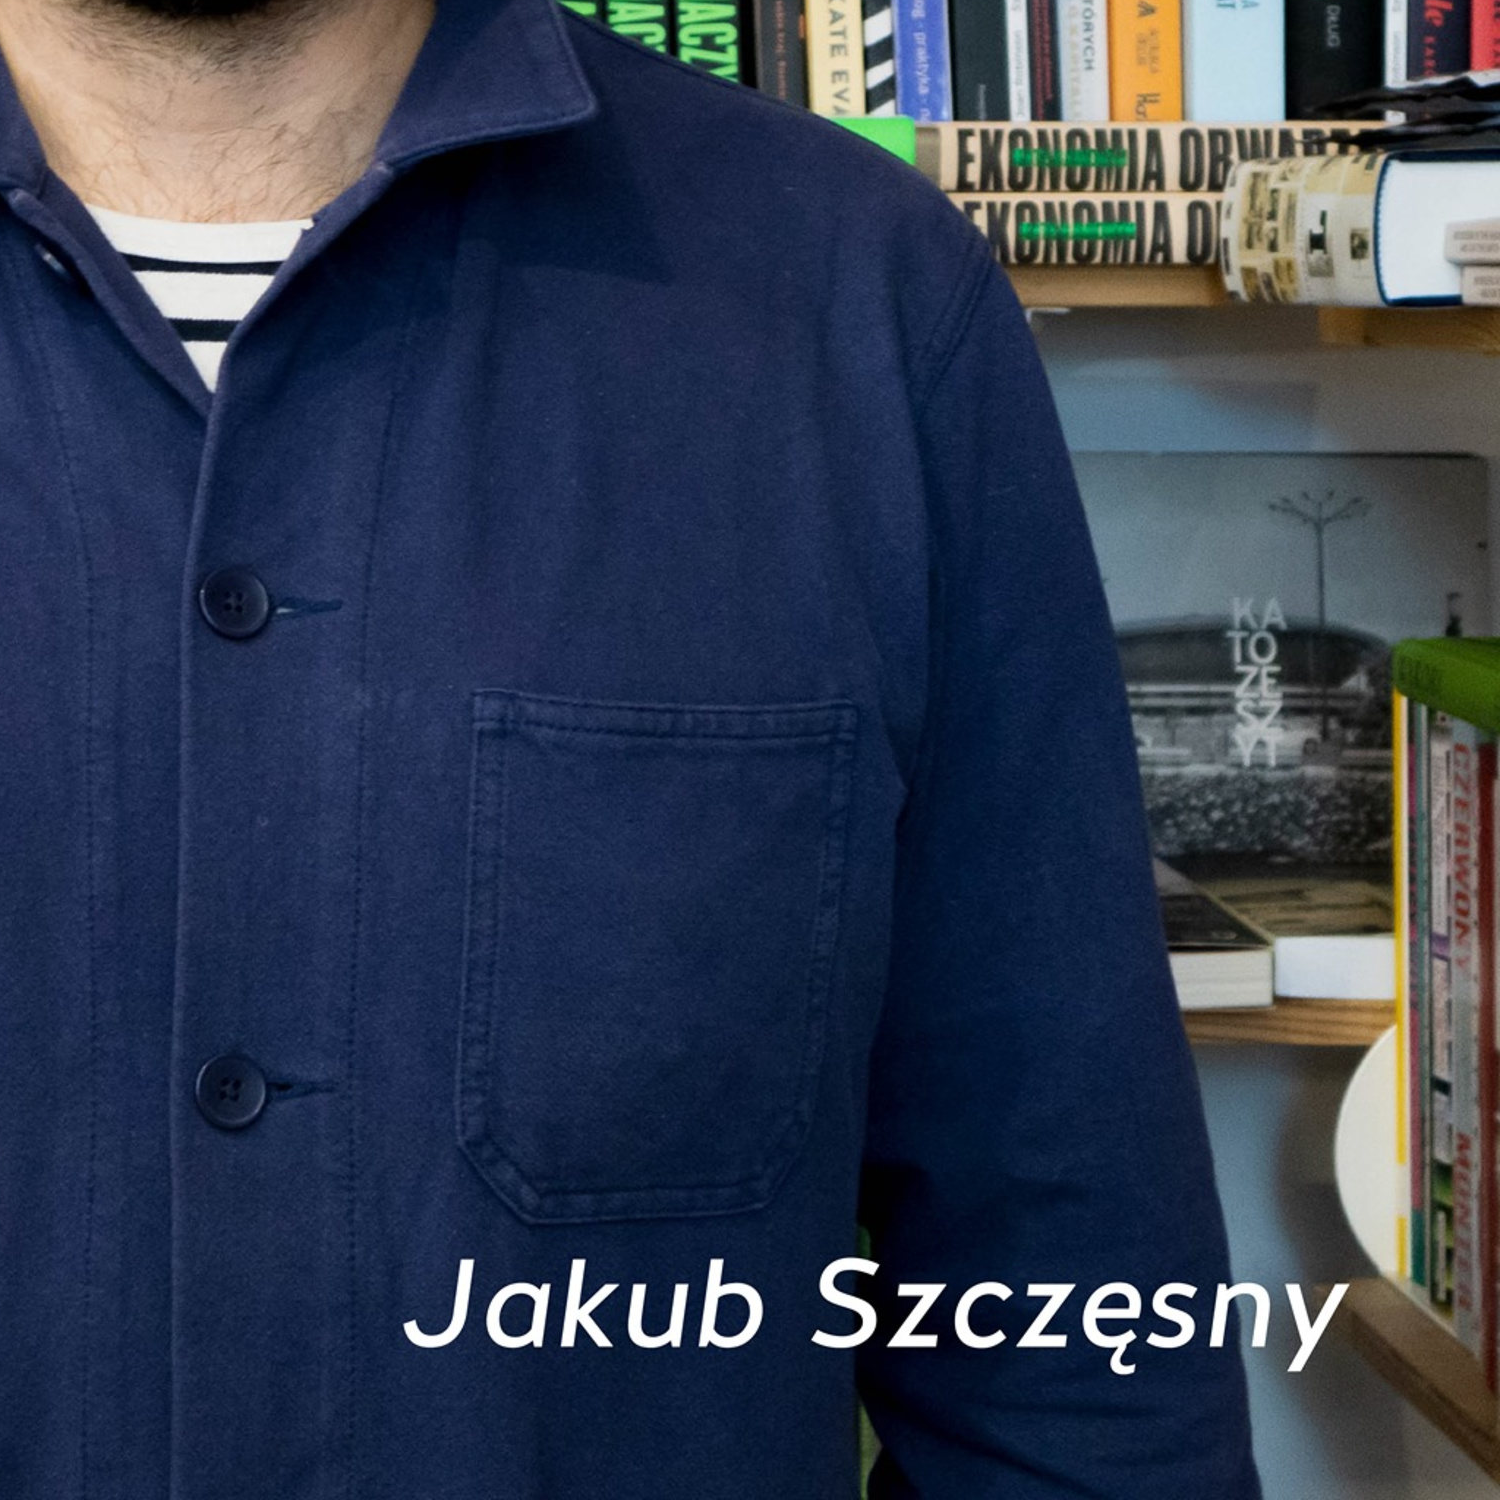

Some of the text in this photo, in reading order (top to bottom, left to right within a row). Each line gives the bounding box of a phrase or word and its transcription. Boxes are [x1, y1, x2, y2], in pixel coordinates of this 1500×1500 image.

[1326, 3, 1341, 48] DŁUG
[831, 69, 850, 116] EVA
[912, 31, 931, 95] praktyka
[958, 129, 1168, 193] EKONOMIA
[968, 200, 1172, 265] EKONOMIA
[1452, 742, 1478, 968] CZERWONY
